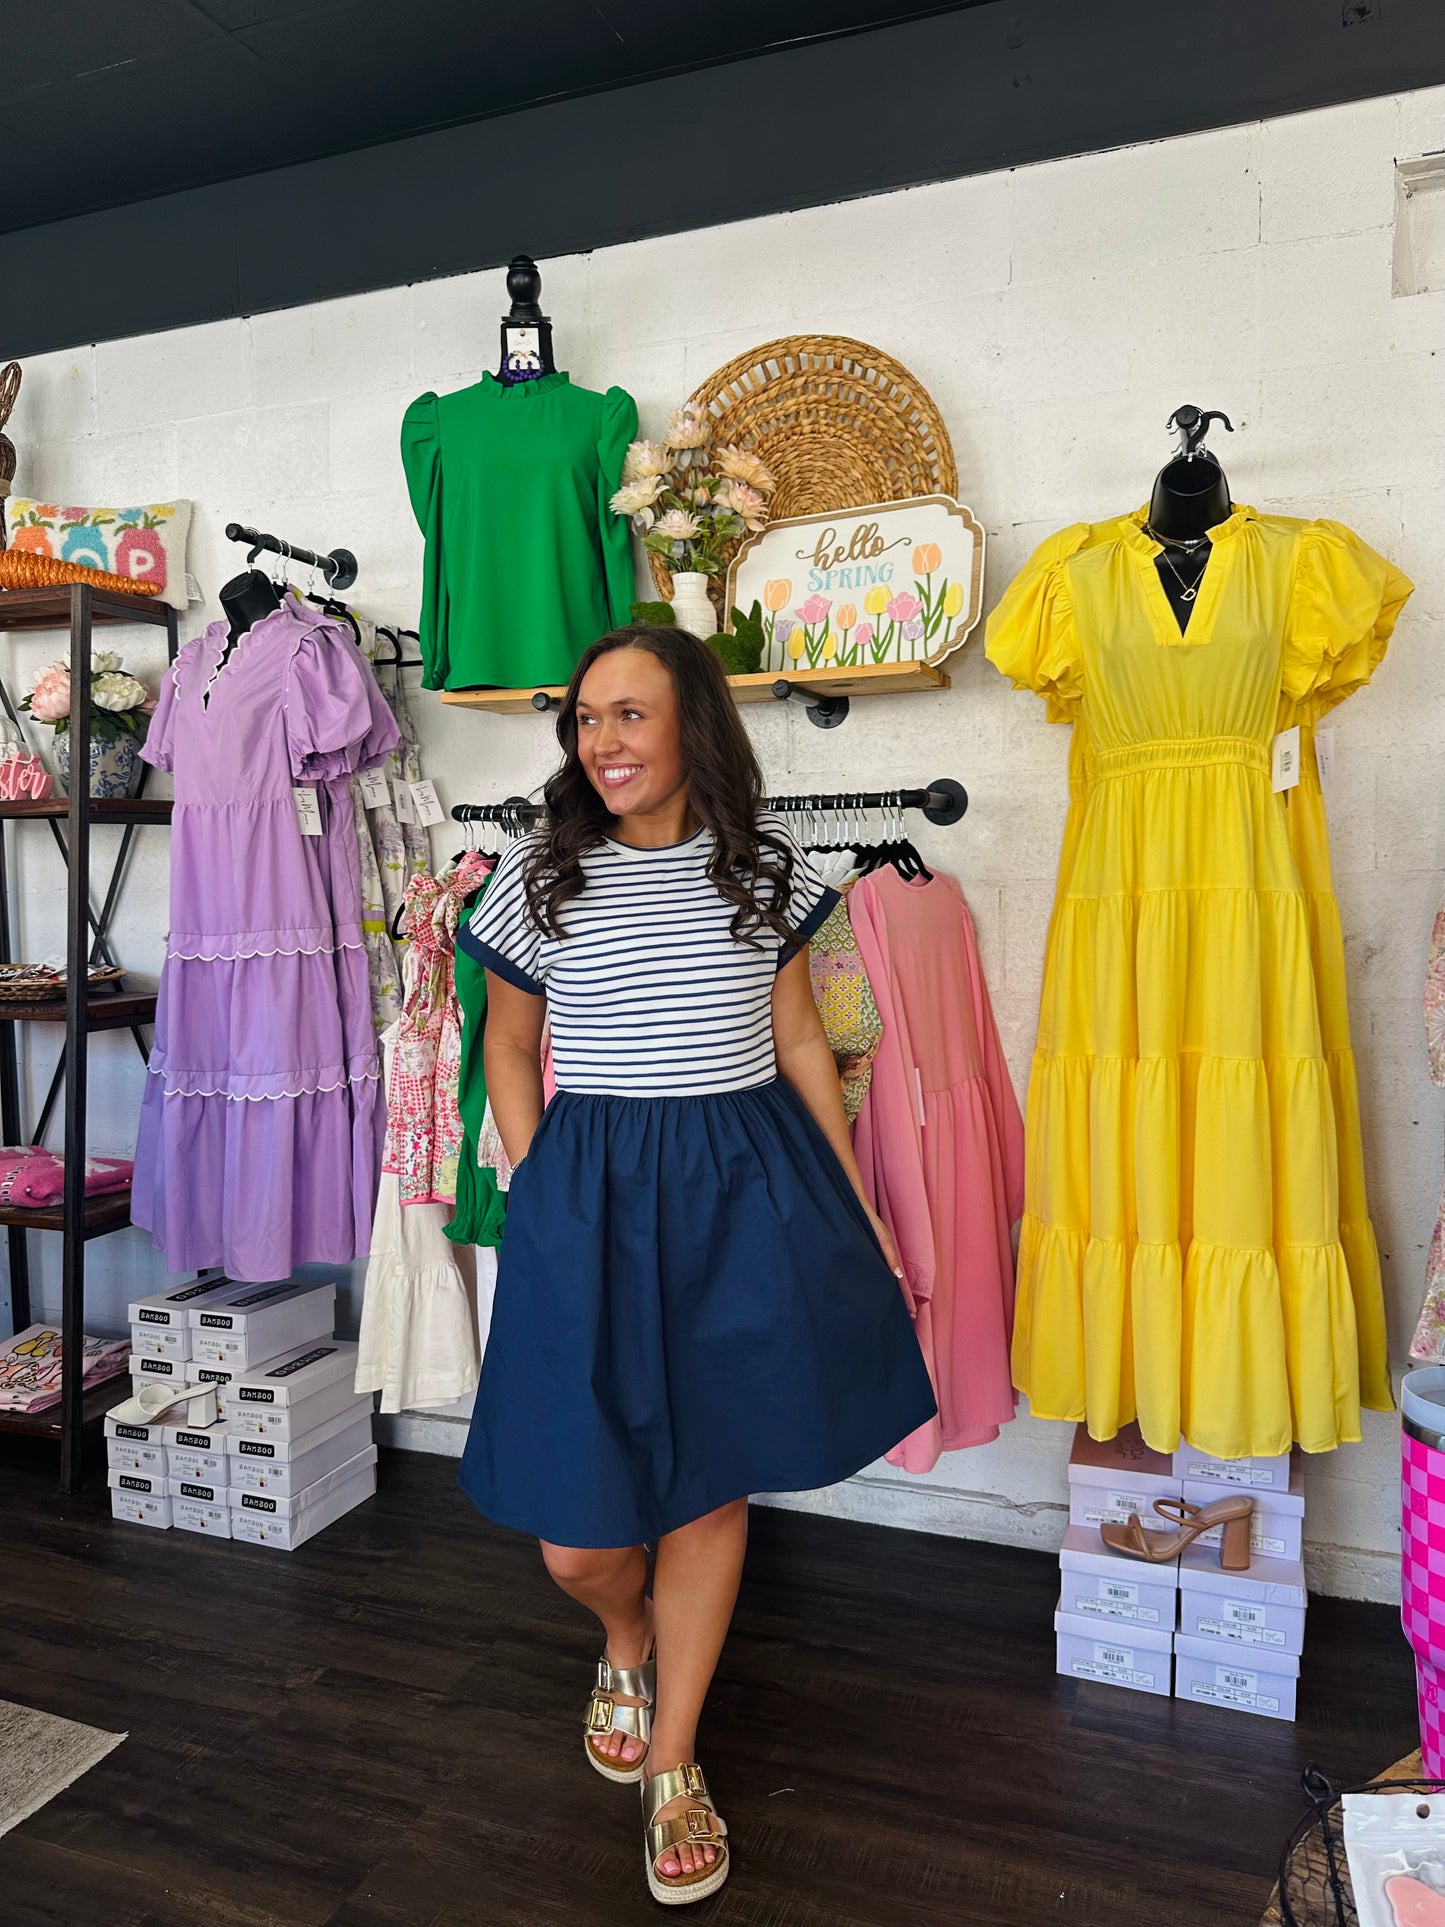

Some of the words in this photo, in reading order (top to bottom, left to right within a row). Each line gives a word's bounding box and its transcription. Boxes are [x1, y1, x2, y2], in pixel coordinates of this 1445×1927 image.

[796, 522, 912, 571] hello
[808, 561, 895, 592] SPRING
[140, 1311, 169, 1322] BAMBOO
[201, 1316, 231, 1327] BAMBOO
[142, 1361, 171, 1373] BAMBOO
[200, 1372, 230, 1383] BAMBOO
[241, 1390, 273, 1401] BAMBOO
[117, 1427, 147, 1438] BAMBOO
[178, 1434, 209, 1446] BAMBOO
[241, 1443, 273, 1455] BAMBOO
[120, 1478, 150, 1490] BAMBOO
[182, 1486, 212, 1498] BAMBOO
[243, 1497, 275, 1509] BAMBOO
